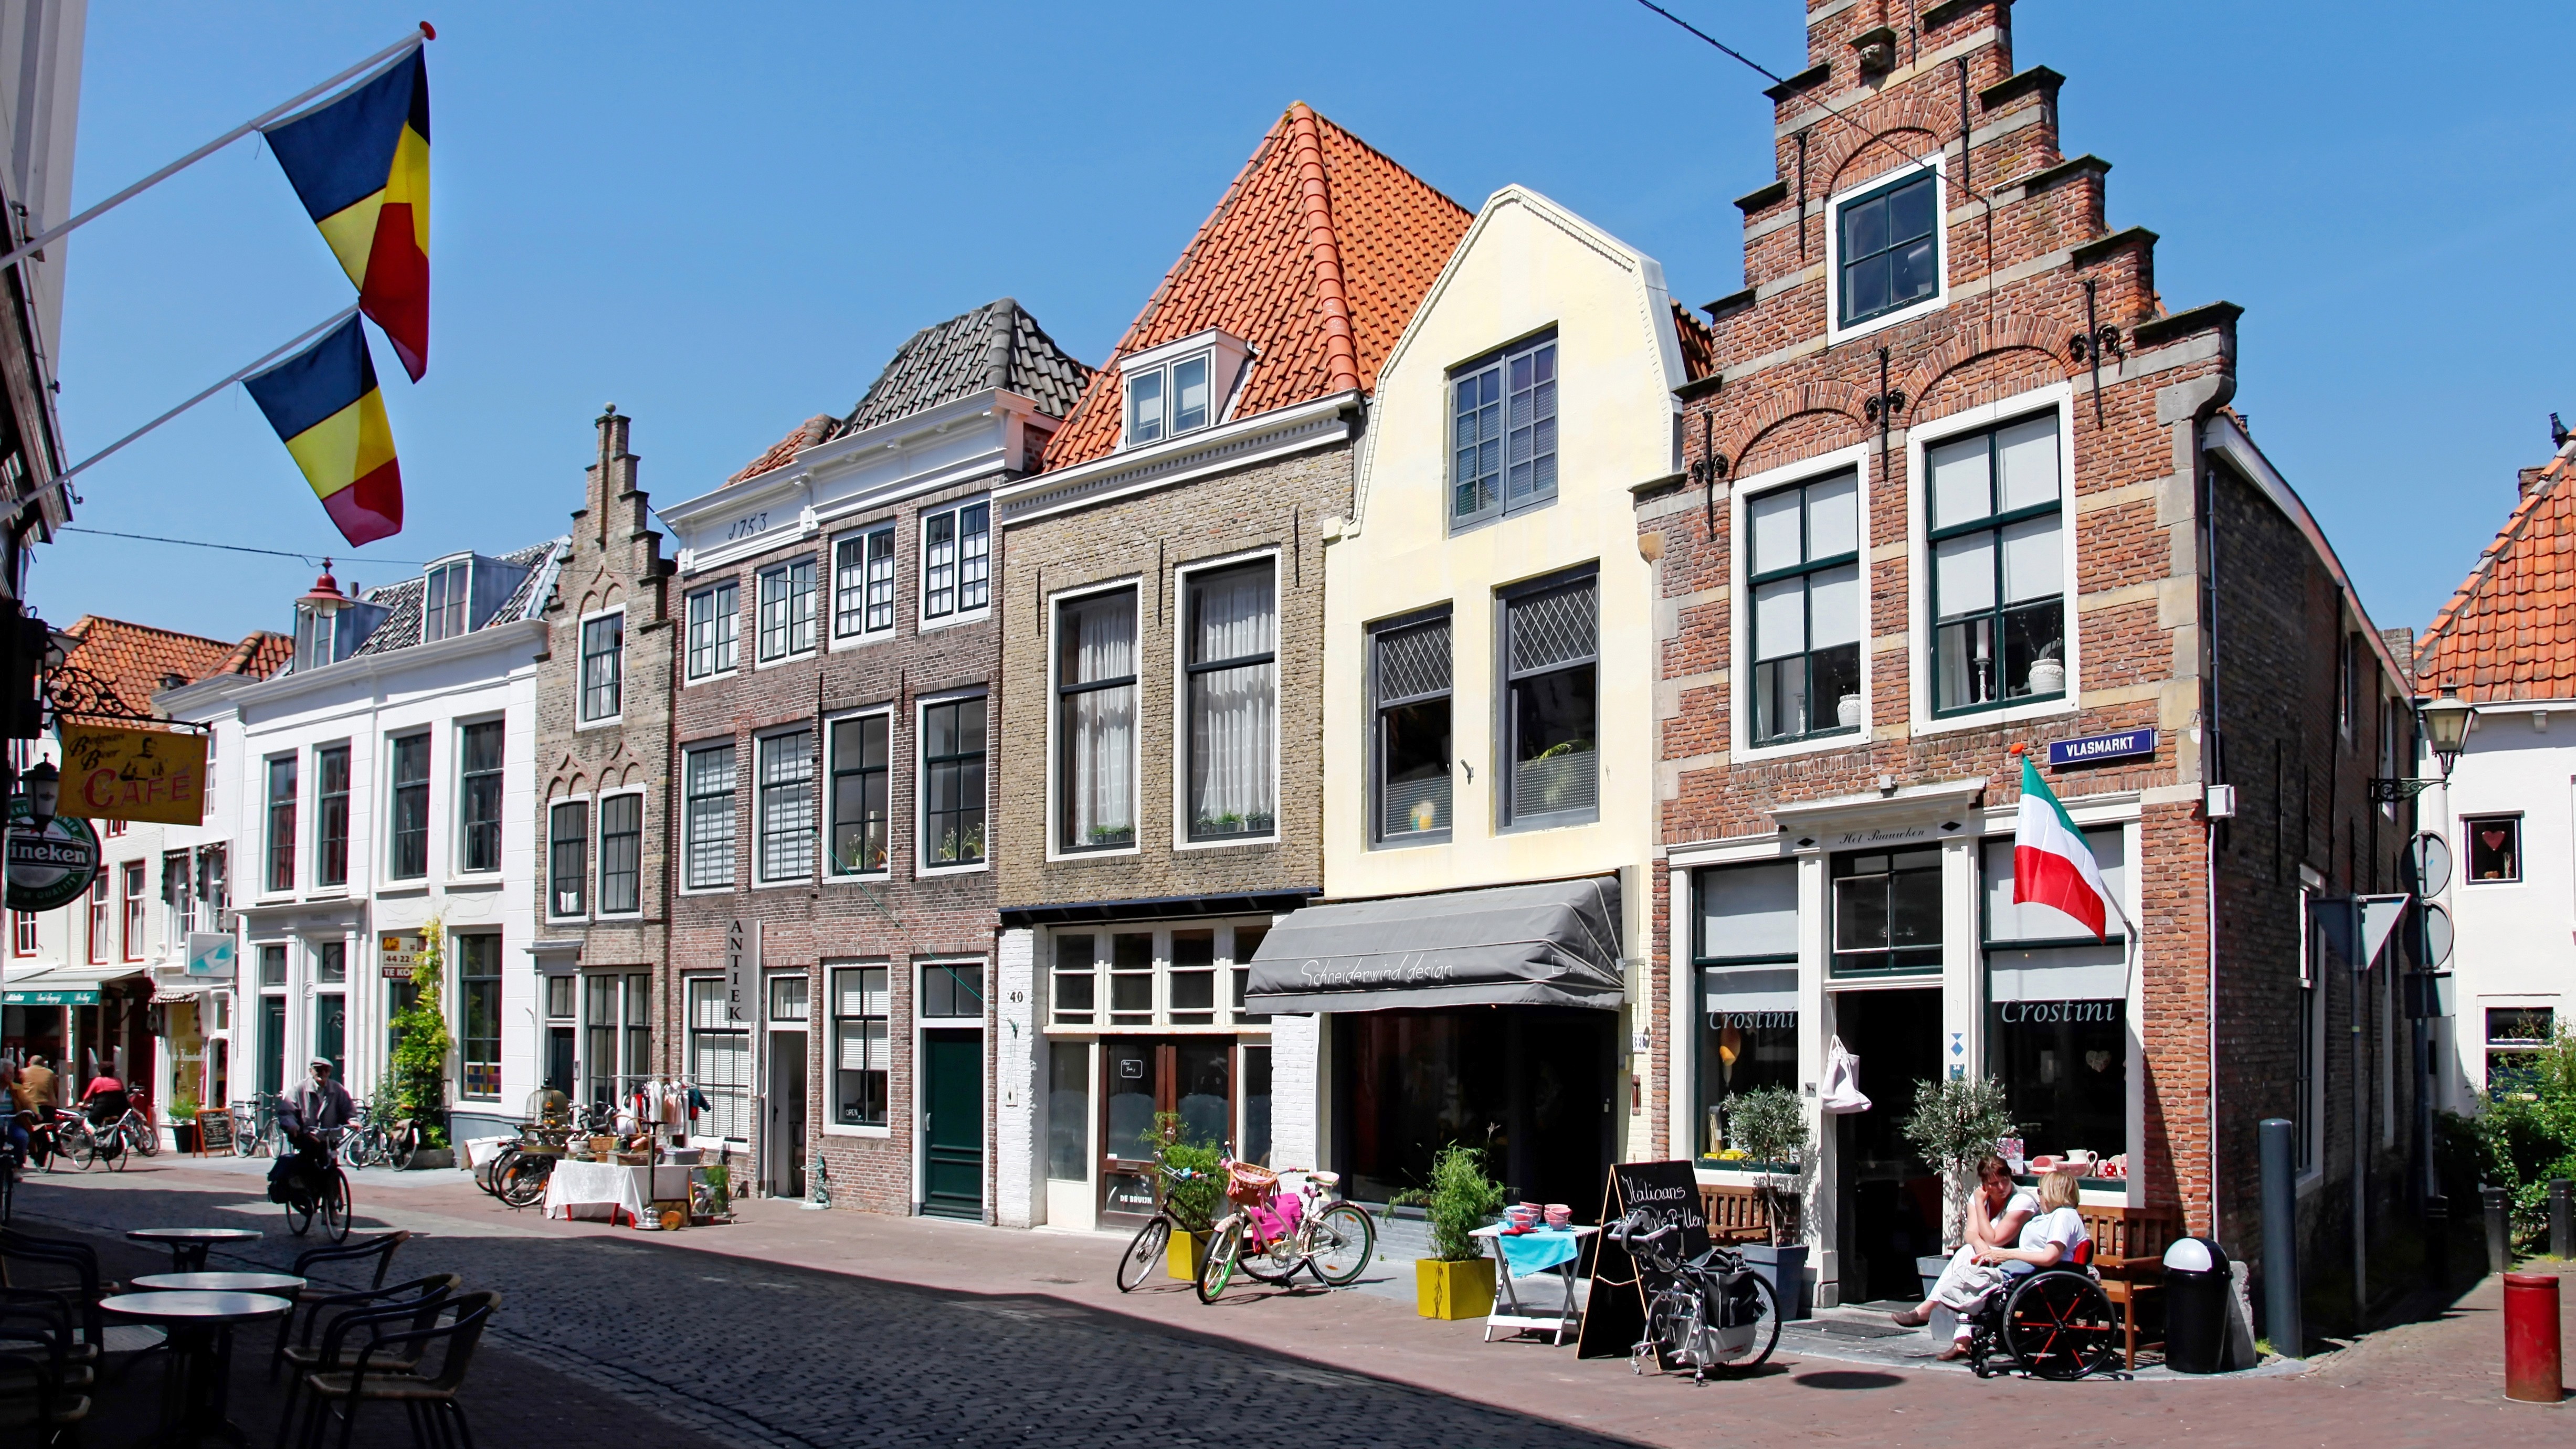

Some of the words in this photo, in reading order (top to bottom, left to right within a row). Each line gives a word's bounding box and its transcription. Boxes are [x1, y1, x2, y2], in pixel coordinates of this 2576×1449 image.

[2066, 736, 2134, 757] VLASMARKT
[1839, 832, 1862, 844] Het
[10, 841, 87, 864] ineken
[383, 968, 395, 976] TE
[396, 968, 416, 976] KO
[729, 920, 743, 1020] ANTIEK
[1298, 954, 1409, 988] Schneiderwind
[1407, 953, 1452, 983] design
[1551, 955, 1595, 976] Design
[1010, 991, 1023, 1002] 40
[1709, 1006, 1796, 1030] Crostini
[2001, 996, 2116, 1023] Crostini
[1129, 1195, 1152, 1204] BRUIJN
[1621, 1175, 1685, 1204] Italiaans
